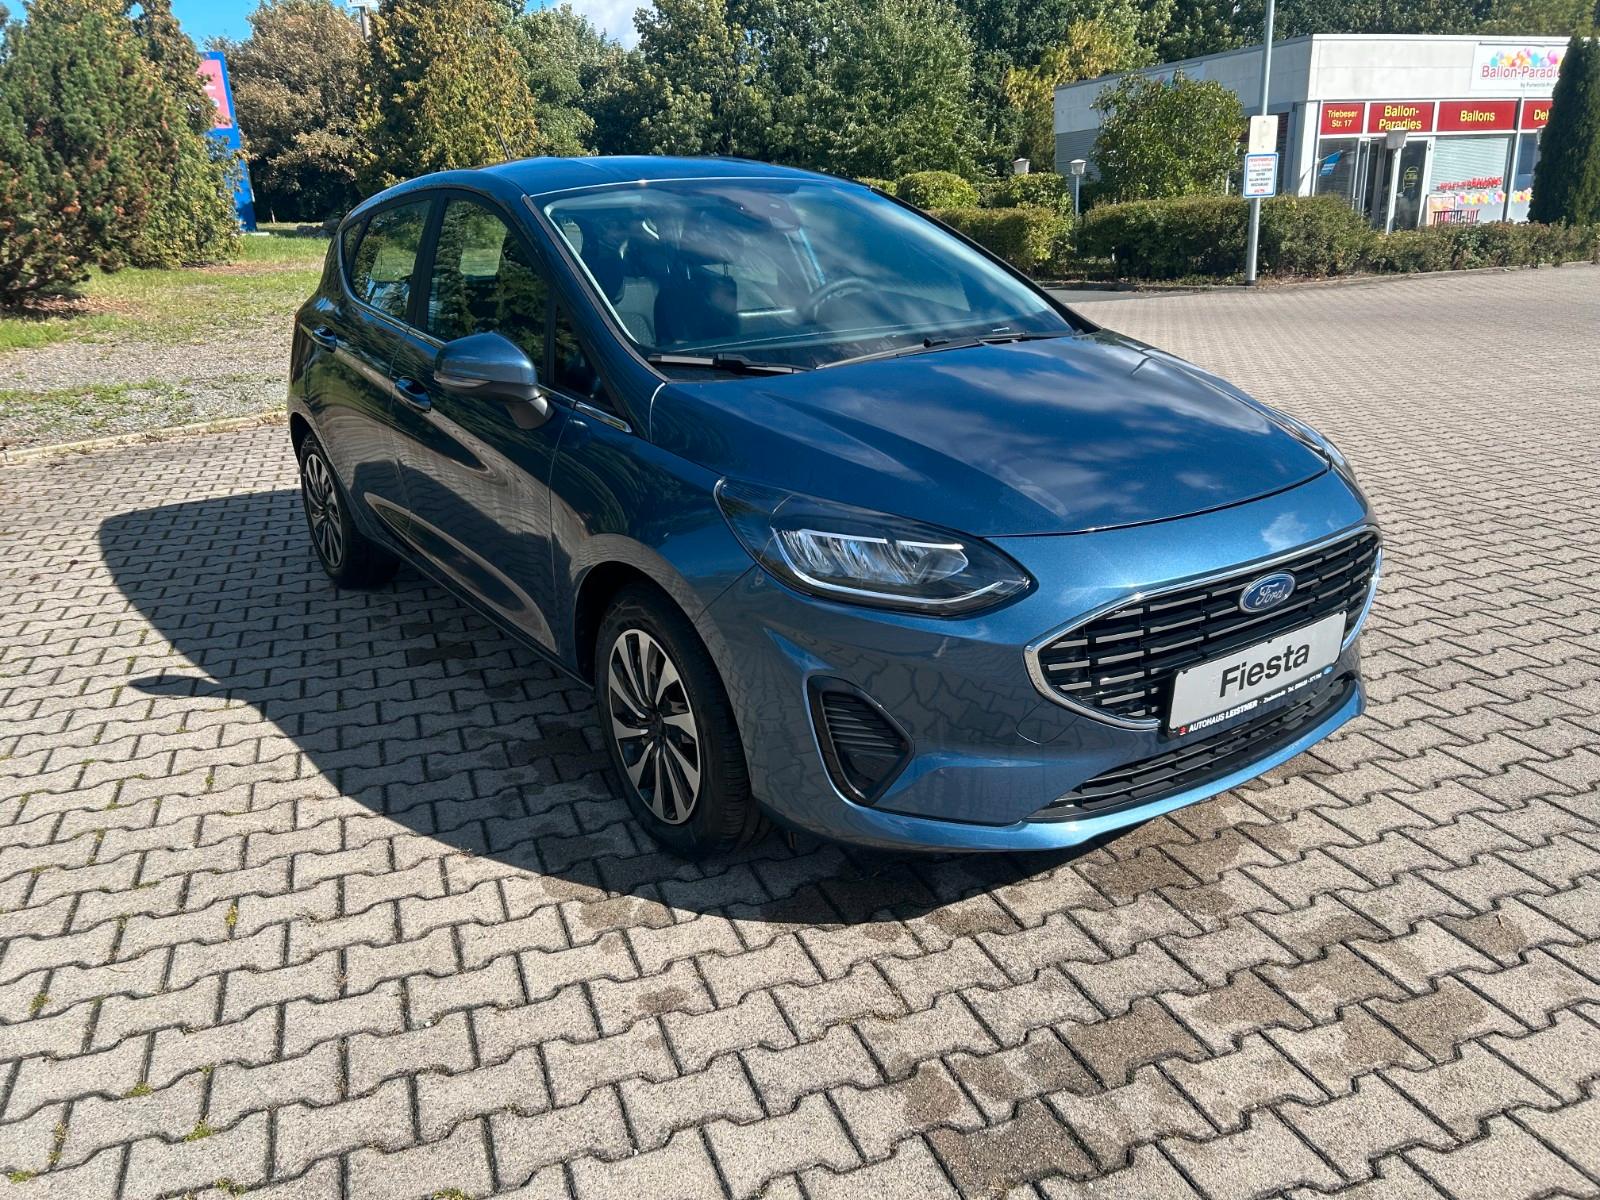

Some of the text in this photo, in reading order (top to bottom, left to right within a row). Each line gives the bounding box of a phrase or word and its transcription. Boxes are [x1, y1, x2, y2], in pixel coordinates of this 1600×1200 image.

[1481, 65, 1561, 78] Ballon-Paradi
[1327, 109, 1358, 118] Triebeser
[1384, 105, 1420, 117] Ballon-
[1460, 110, 1495, 121] Ballons
[1344, 119, 1353, 127] 17
[1378, 118, 1422, 130] Paradies
[1254, 582, 1286, 606] Ford
[1219, 643, 1310, 697] Fiesta
[1188, 712, 1225, 732] AUTOHAUS
